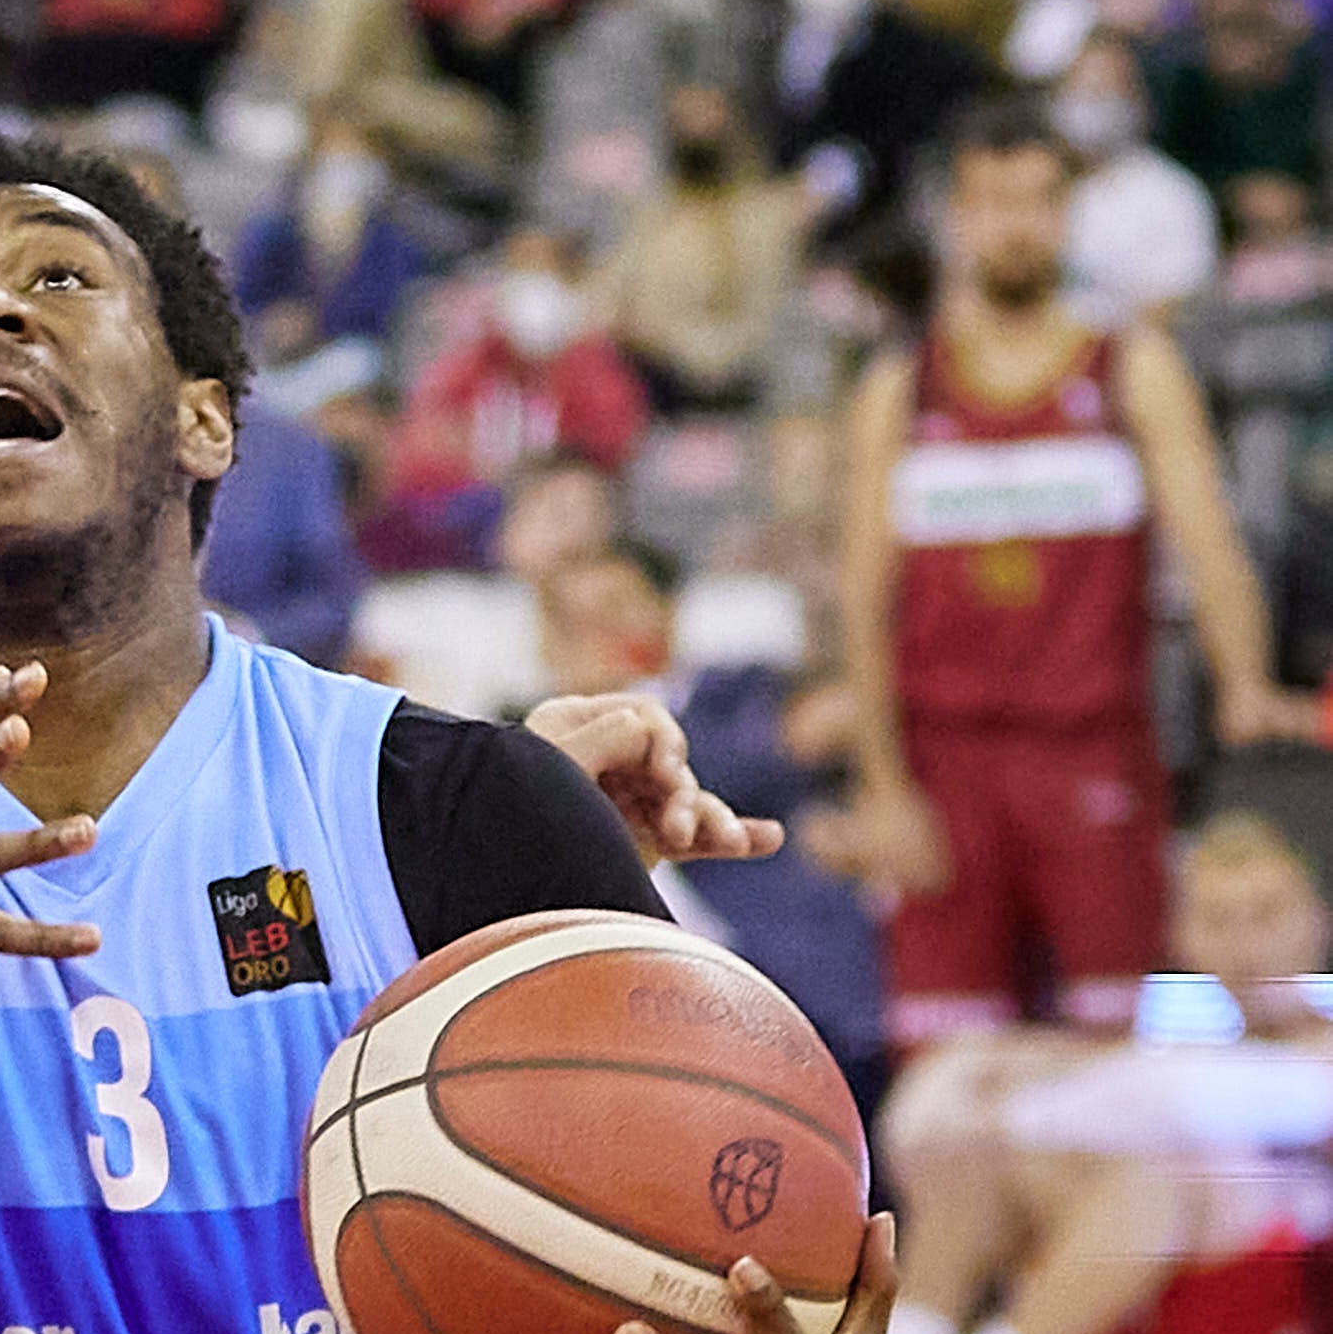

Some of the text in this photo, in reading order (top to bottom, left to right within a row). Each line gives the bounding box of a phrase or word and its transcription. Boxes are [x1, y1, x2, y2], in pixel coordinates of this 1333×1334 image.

[225, 922, 289, 959] LEB
[233, 955, 290, 985] ORO
[70, 994, 170, 1212] 3
